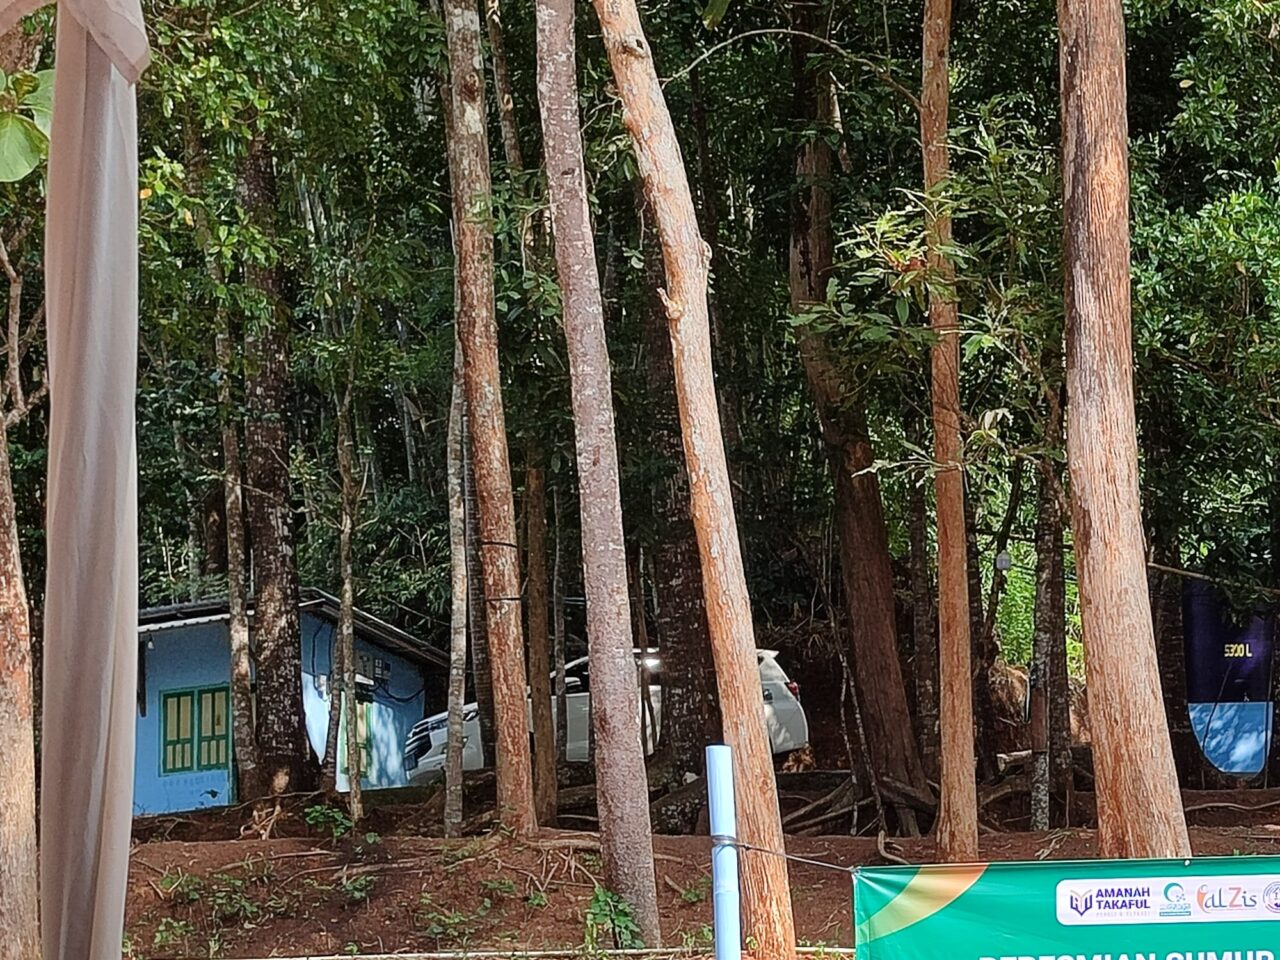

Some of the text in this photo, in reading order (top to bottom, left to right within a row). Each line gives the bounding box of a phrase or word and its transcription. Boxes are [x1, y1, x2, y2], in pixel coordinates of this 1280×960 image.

[1246, 643, 1252, 657] L
[1095, 887, 1150, 898] AMANAH
[1096, 899, 1150, 910] TAKAFUL
